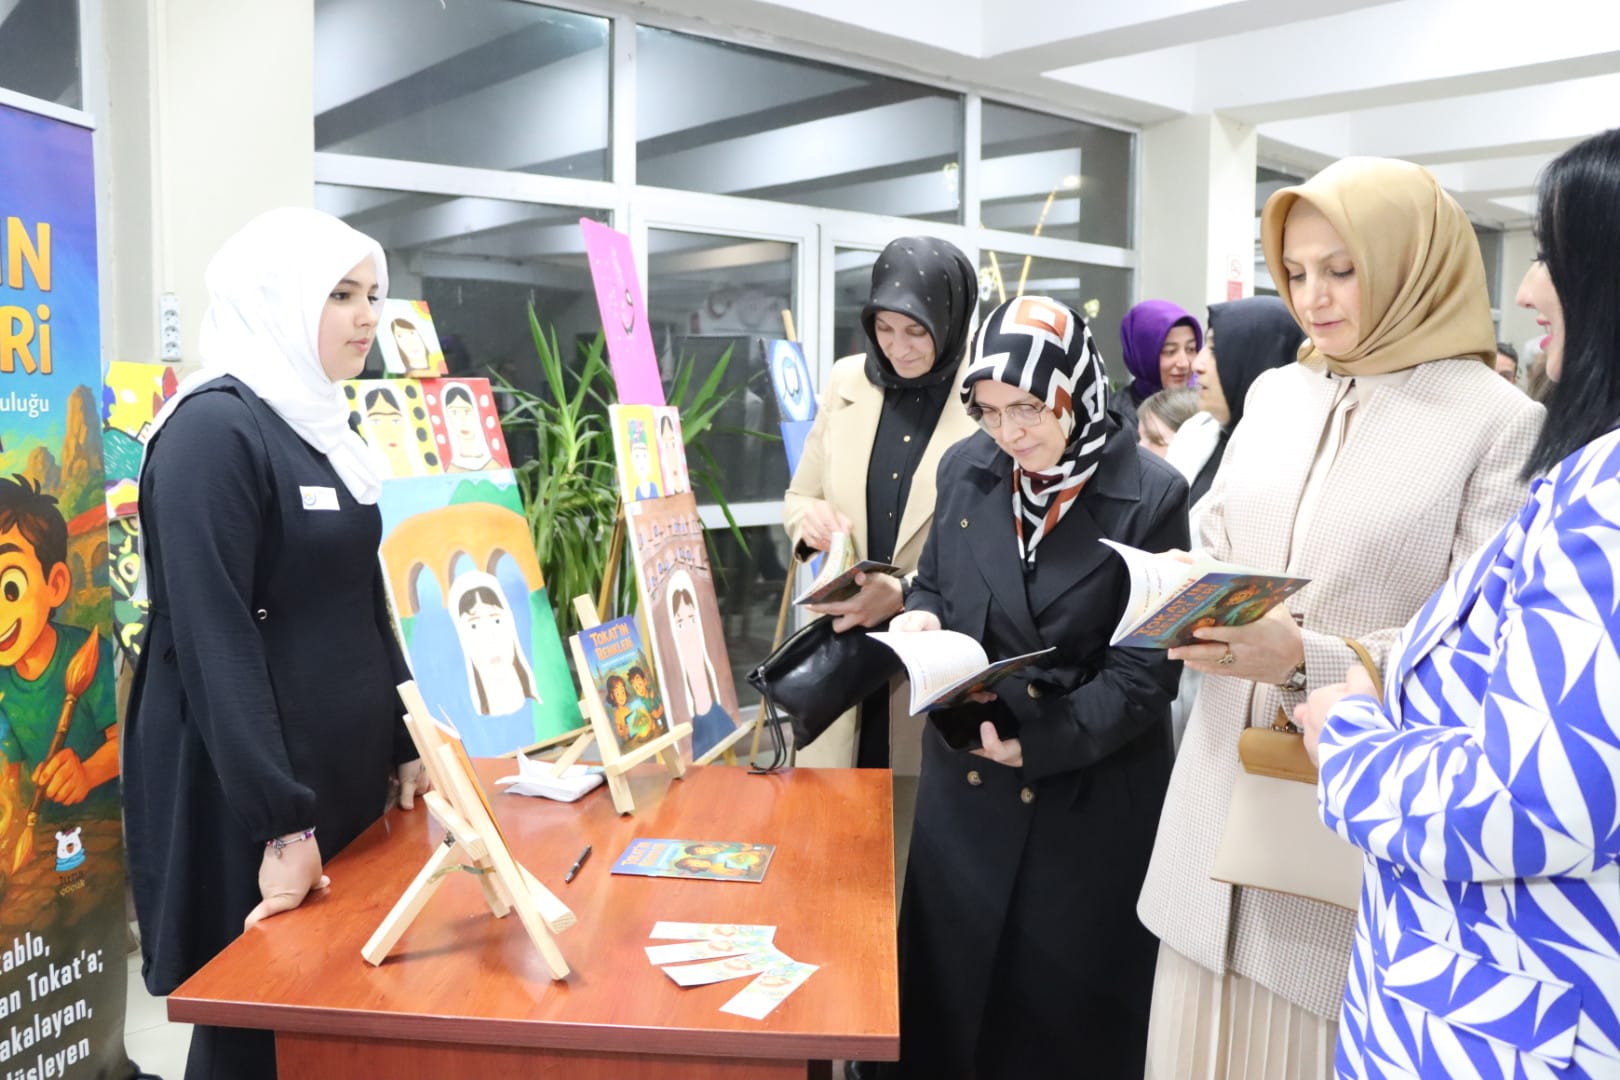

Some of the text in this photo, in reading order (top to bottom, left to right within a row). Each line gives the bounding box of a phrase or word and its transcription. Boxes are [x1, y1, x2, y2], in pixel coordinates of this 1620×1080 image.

[0, 216, 52, 291] N
[0, 931, 50, 976] ablo,
[27, 949, 103, 1002] Tokat'a;
[0, 999, 93, 1063] akalayan,
[6, 1038, 90, 1080] leyen
